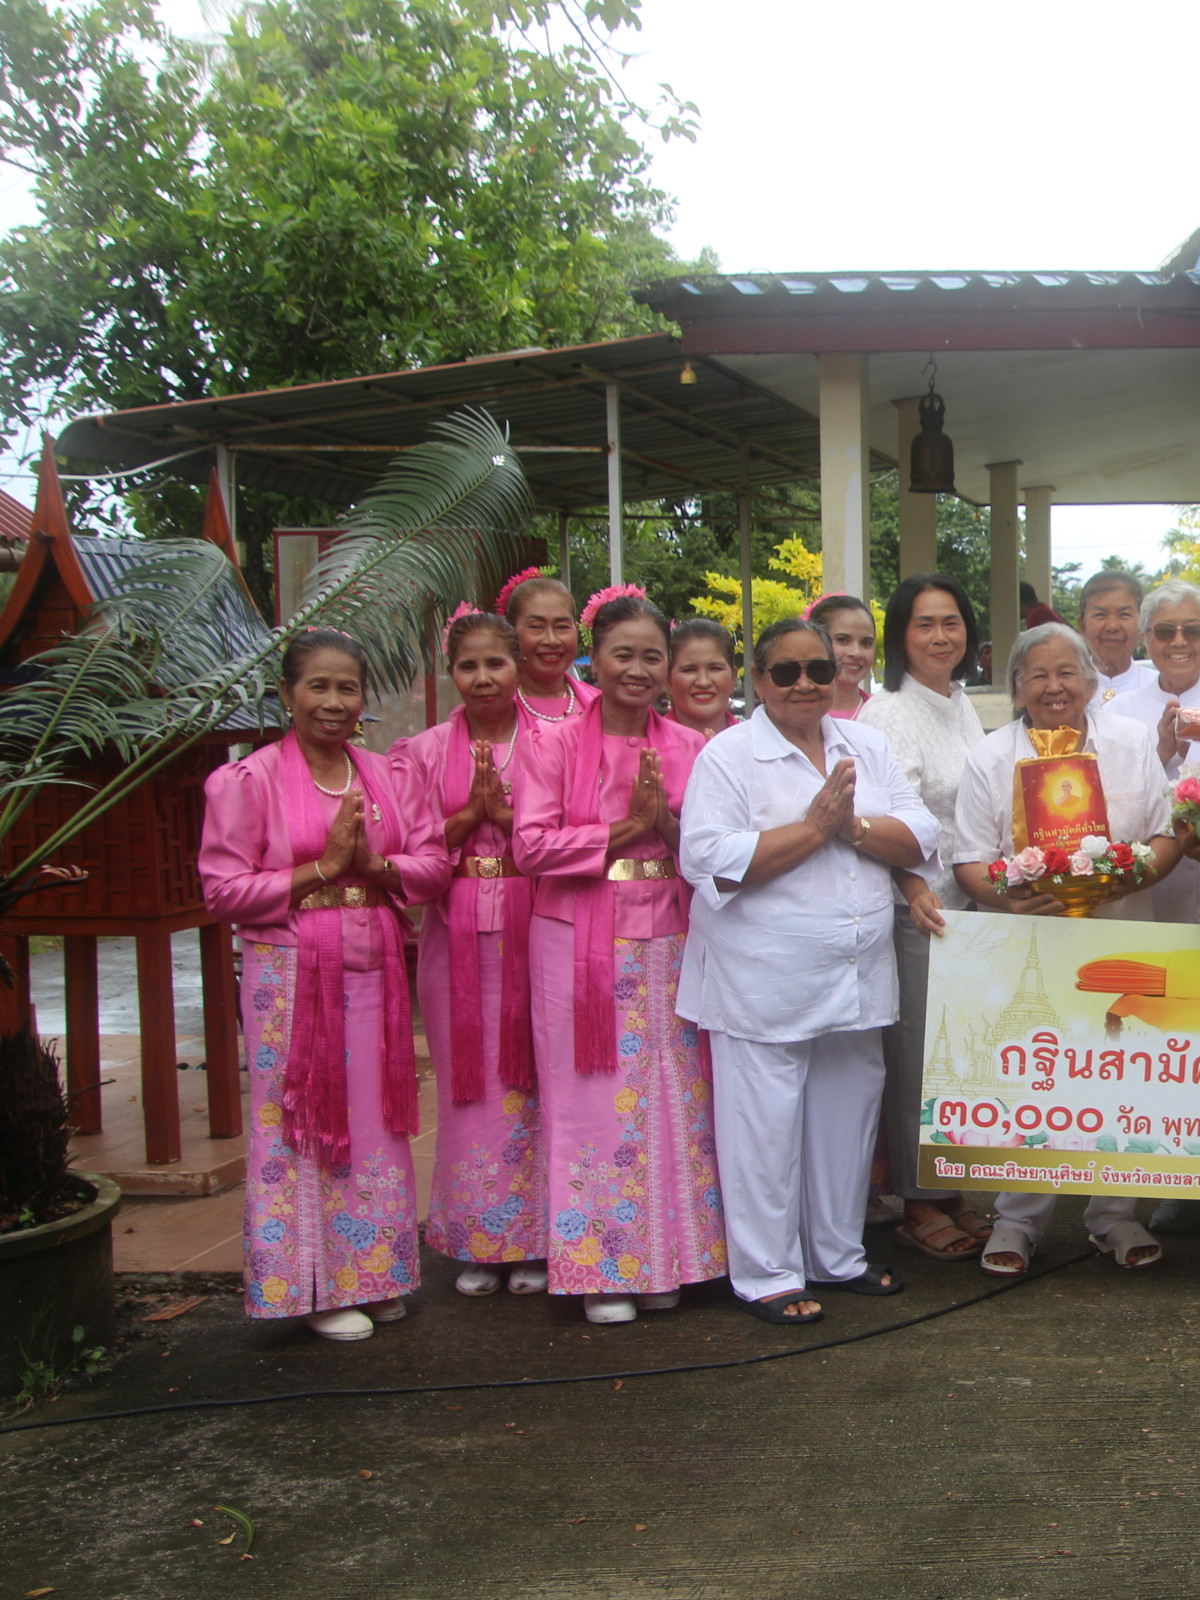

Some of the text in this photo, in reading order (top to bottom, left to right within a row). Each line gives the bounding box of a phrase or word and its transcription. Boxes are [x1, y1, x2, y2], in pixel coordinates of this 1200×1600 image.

[939, 1100, 1104, 1136] ๓๐,๐๐๐
[1116, 1105, 1152, 1136] วัด
[935, 1157, 965, 1177] โดย
[971, 1161, 1096, 1187] คณะศิษยานุศิษย์
